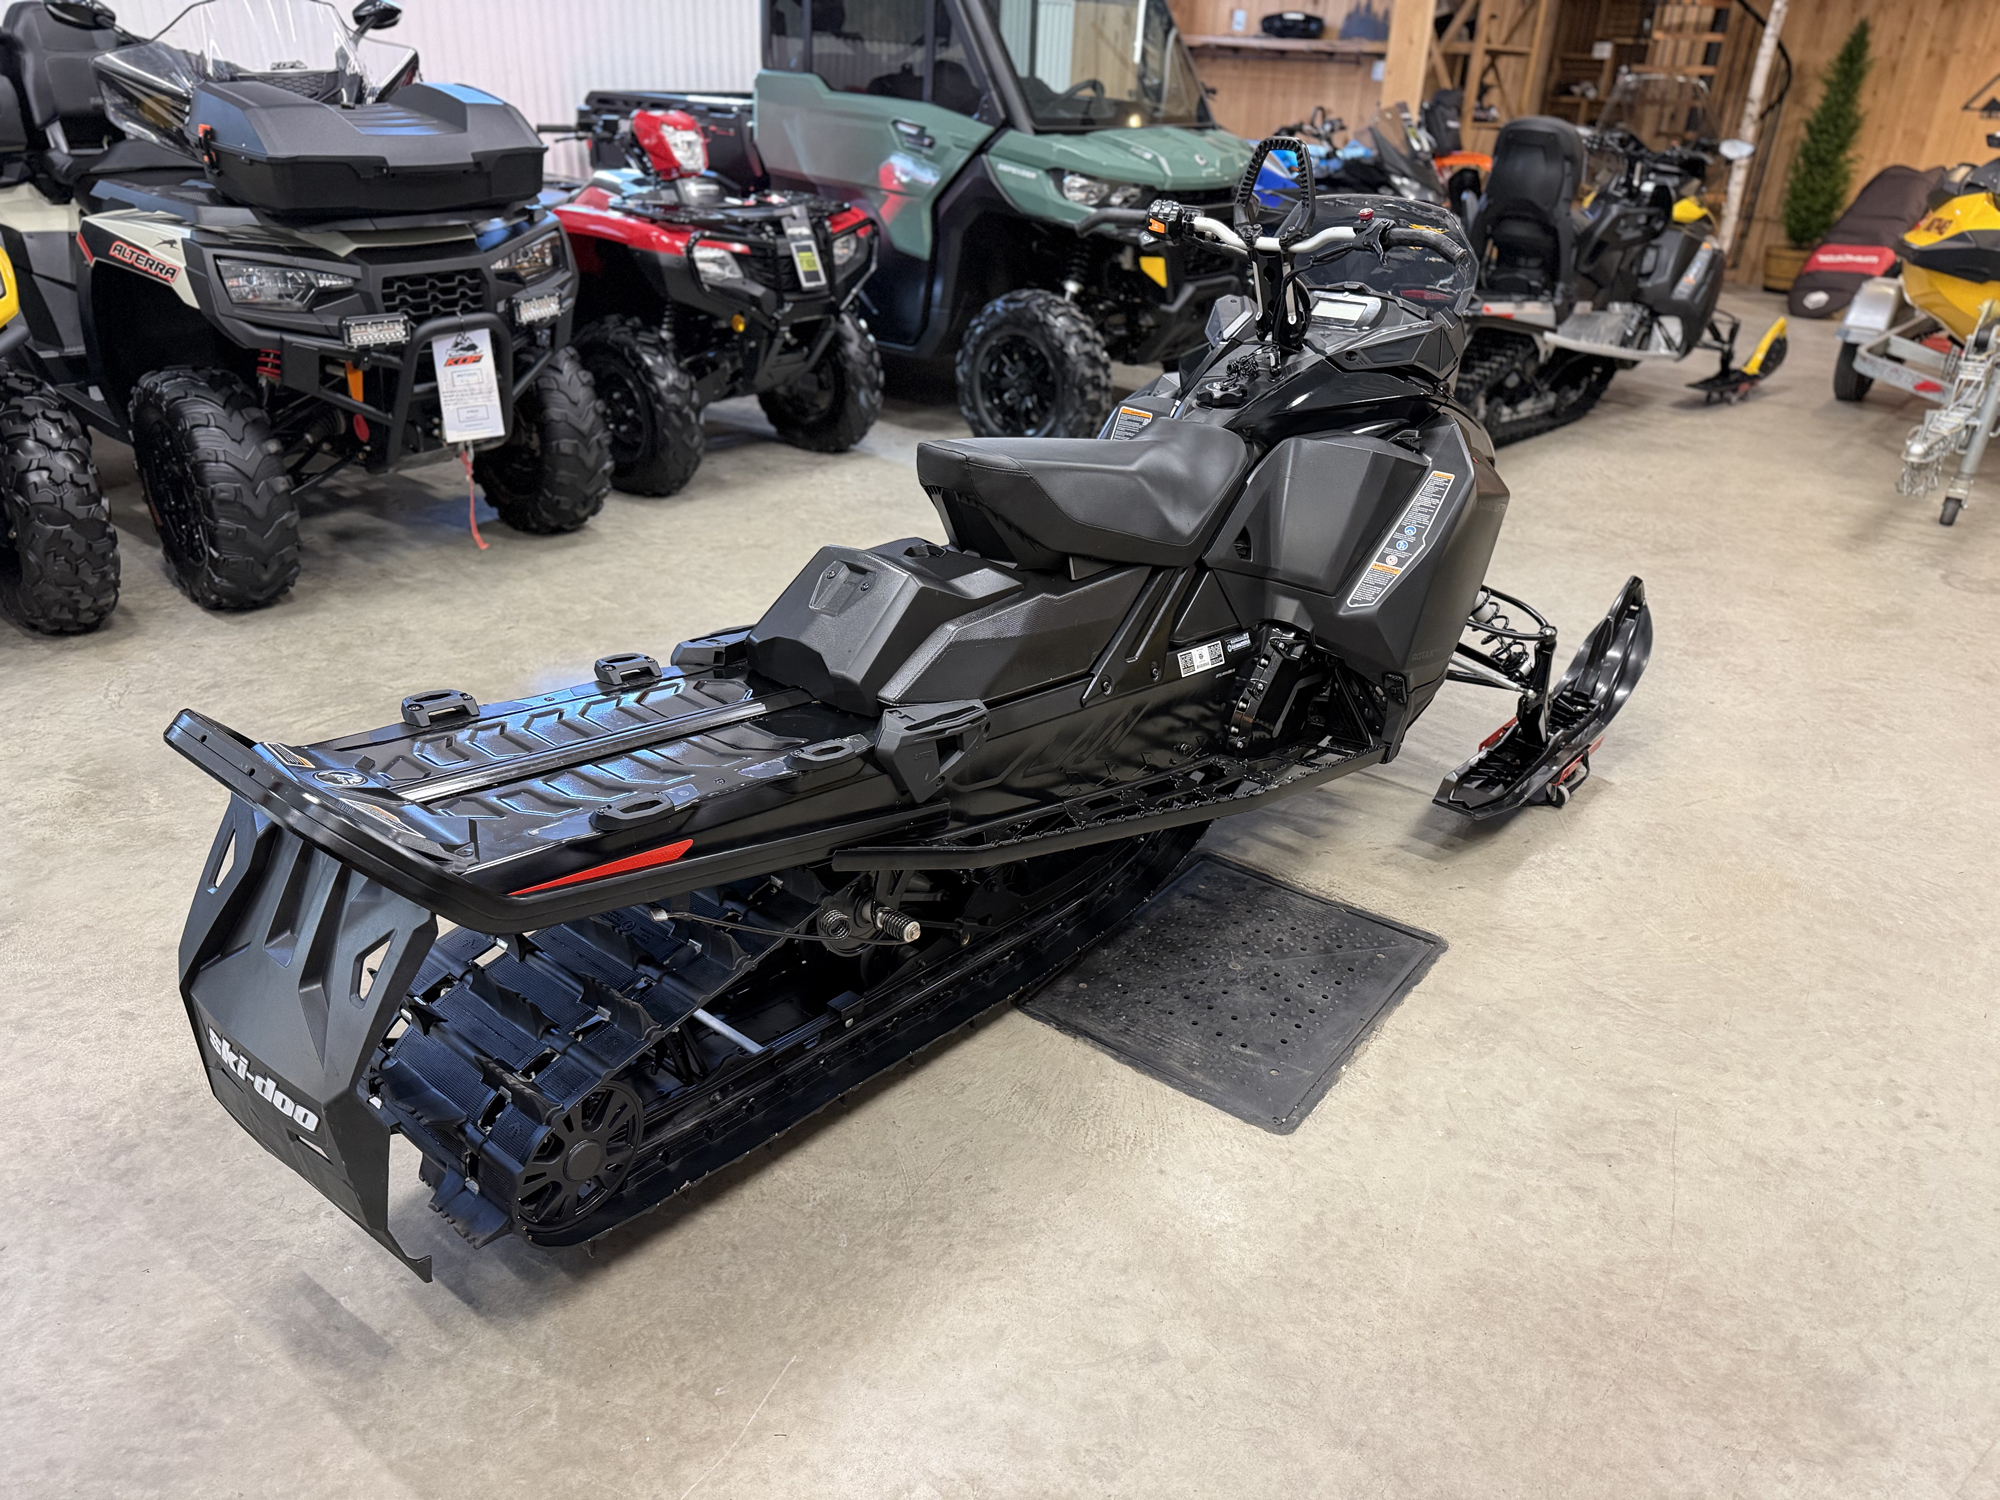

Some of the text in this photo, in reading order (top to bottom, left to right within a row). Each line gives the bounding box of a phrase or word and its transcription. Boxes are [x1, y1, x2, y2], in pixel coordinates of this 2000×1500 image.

[111, 242, 178, 280] ALTERRA
[1412, 650, 1434, 661] ROTAX
[208, 1026, 320, 1132] ski-doo
